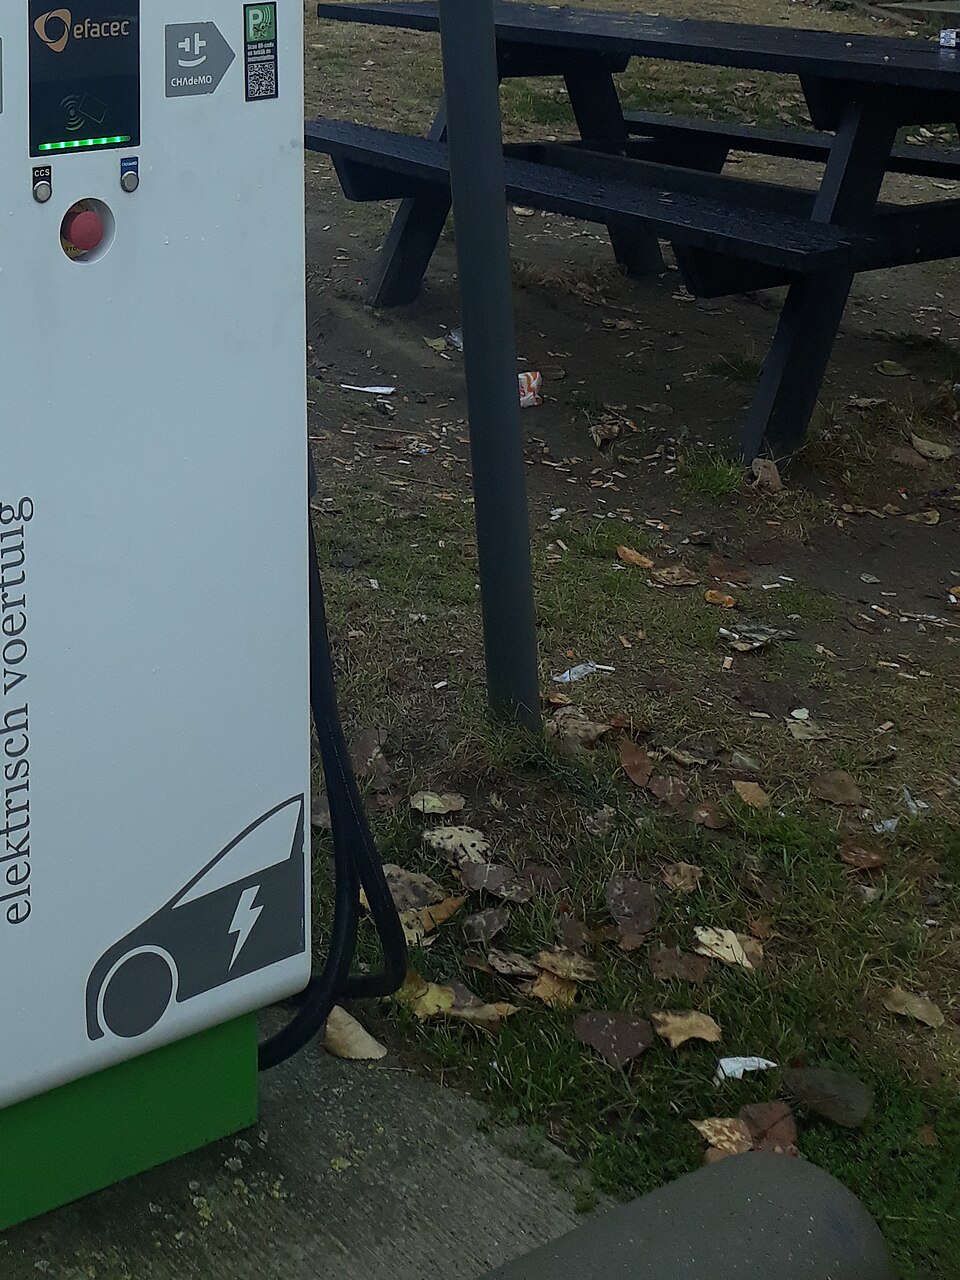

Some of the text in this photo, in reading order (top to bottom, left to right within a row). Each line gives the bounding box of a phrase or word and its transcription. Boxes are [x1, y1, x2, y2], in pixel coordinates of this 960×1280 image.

[73, 19, 130, 39] efacec
[170, 75, 213, 87] CHAdeMO
[34, 168, 50, 177] CCS
